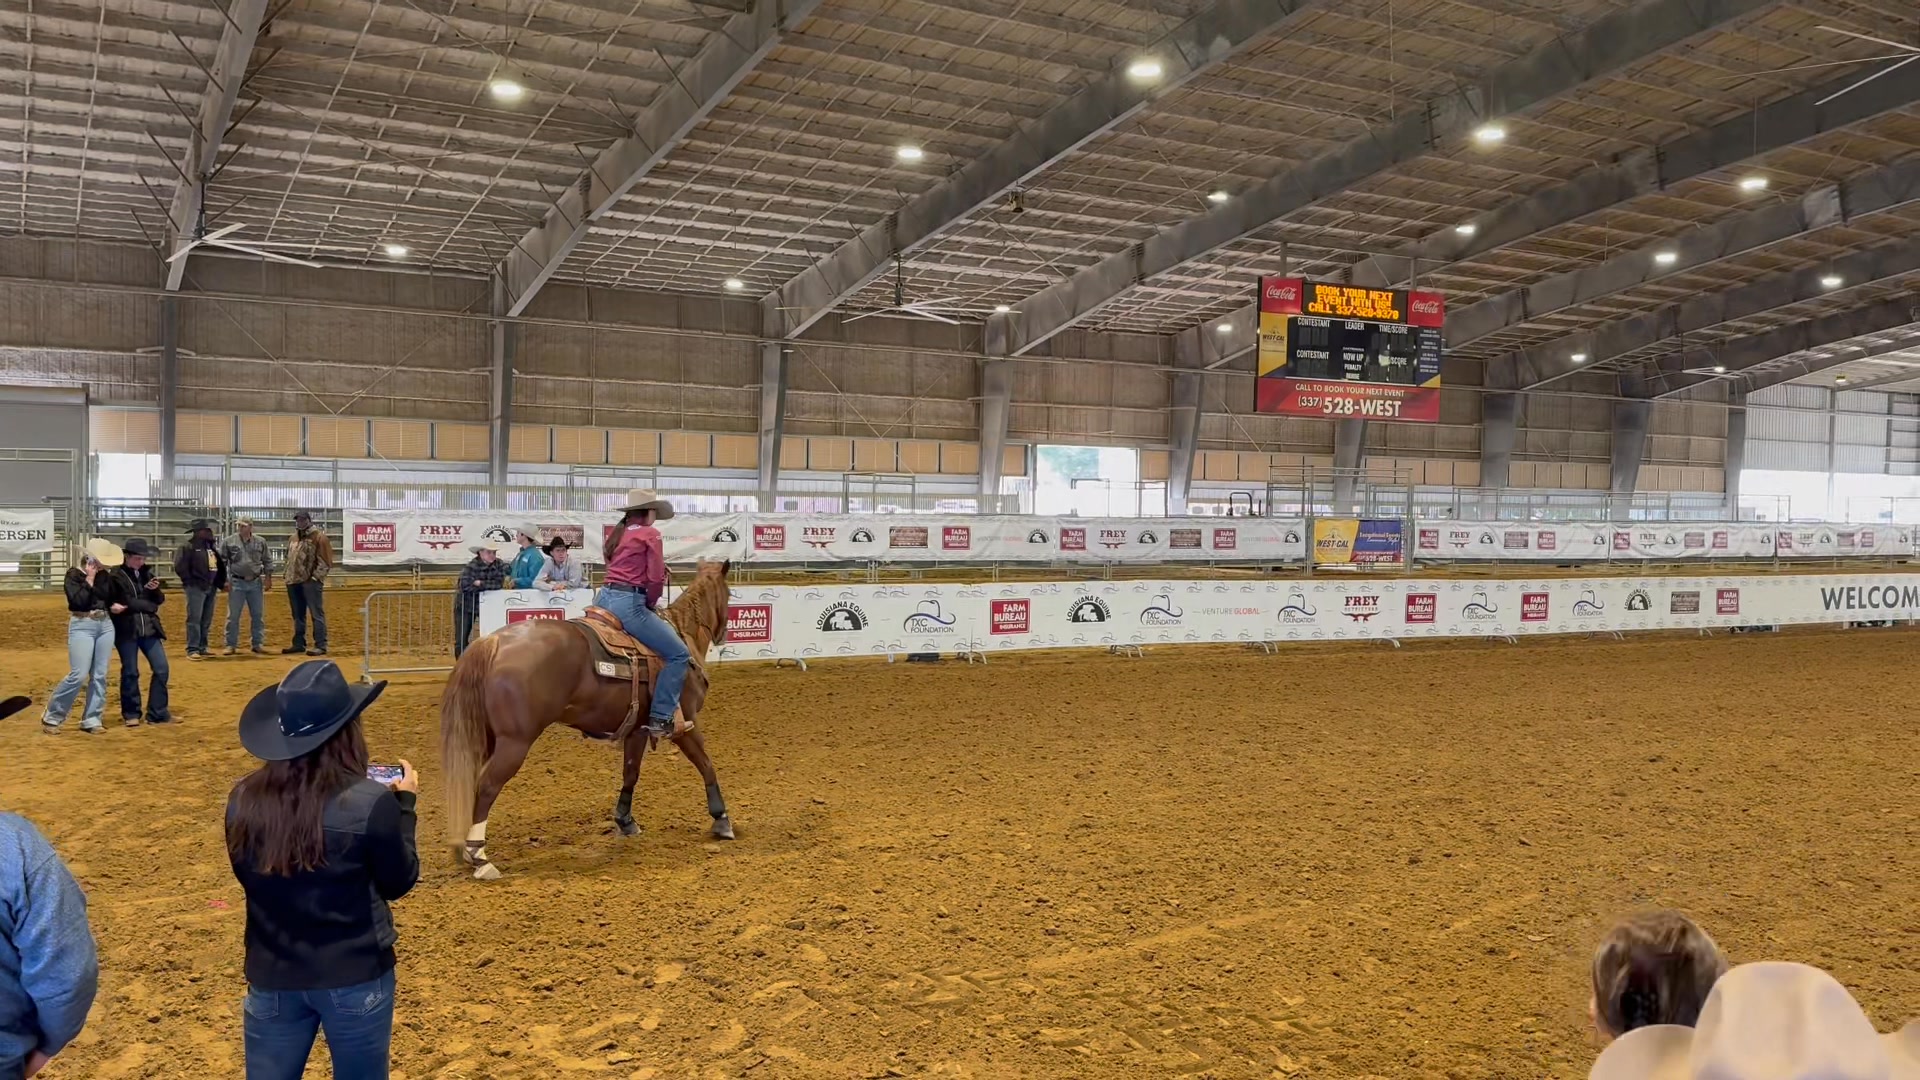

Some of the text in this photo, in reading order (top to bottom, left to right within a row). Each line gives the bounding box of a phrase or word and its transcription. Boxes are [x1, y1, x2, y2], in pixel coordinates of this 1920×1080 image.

[1315, 284, 1394, 300] BOOK YOUR NEXT
[1318, 294, 1347, 306] EVENT
[1351, 297, 1372, 308] WITH
[1308, 302, 1332, 314] CALL
[1297, 317, 1331, 328] CONTESTANT
[1344, 321, 1365, 330] LEADER
[1379, 324, 1408, 335] TIME/SCORE
[1296, 349, 1330, 360] CONTESTANT
[1343, 352, 1364, 362] NOW UP
[1344, 363, 1362, 371] PENALTY
[1295, 383, 1405, 397] CALL TO BOOK YOUR NEXT EVENT
[1298, 395, 1402, 417] (337) 528-WEST
[366, 526, 391, 534] FARM
[419, 525, 464, 535] FREY
[763, 527, 782, 535] FARM
[802, 527, 836, 536] FREY
[1100, 529, 1127, 538] FREY
[357, 533, 392, 542] BUREAU
[1344, 595, 1380, 606] FREY
[1415, 597, 1433, 605] FARM
[1003, 603, 1026, 612] FARM
[1066, 595, 1112, 621] LOUISIANA EQUINE
[1233, 607, 1260, 615] GLOBAL
[1408, 604, 1433, 613] BUREAU
[1523, 603, 1546, 611] BUREAU
[737, 608, 767, 619] FARM
[816, 601, 869, 630] LOUISIANA EQUINE
[993, 611, 1027, 621] BUREAU
[1146, 611, 1160, 620] TXC
[1283, 610, 1296, 618] TXC
[726, 618, 767, 629] BUREAU
[911, 618, 928, 627] TXC
[910, 626, 955, 634] FOUNDATION
